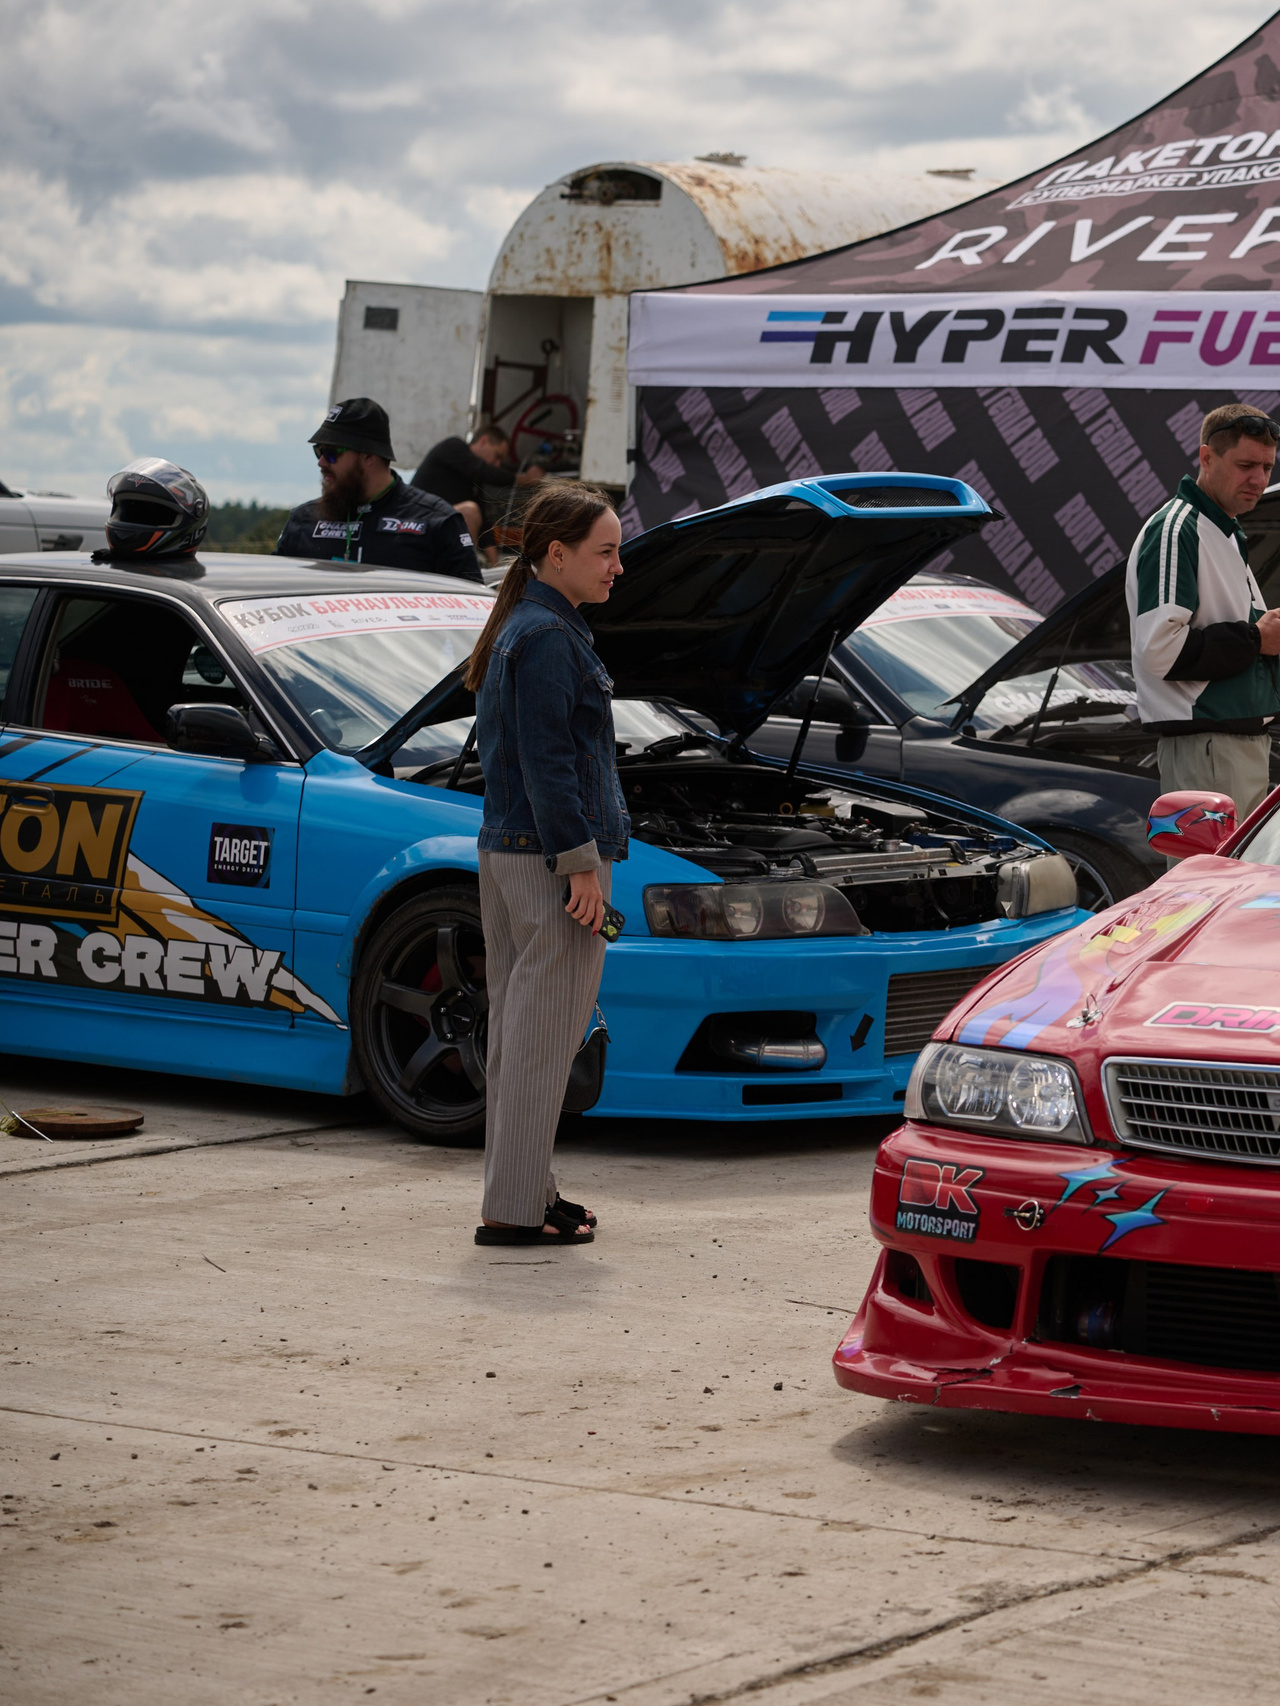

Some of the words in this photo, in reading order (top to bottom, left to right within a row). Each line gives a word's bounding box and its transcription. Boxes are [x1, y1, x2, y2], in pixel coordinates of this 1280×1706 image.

[1022, 172, 1197, 205] СУПЕРМАРКЕТ
[800, 308, 1131, 365] HYPER
[233, 602, 313, 629] КУБОК
[308, 594, 469, 615] БАРНАУЛЬСКОЙ
[68, 678, 113, 689] BRIDE
[0, 794, 125, 880] ON
[214, 836, 268, 866] TARGET
[214, 864, 240, 873] ENERGY
[242, 866, 264, 874] DRINK
[77, 931, 281, 1002] CREW
[899, 1159, 984, 1215] DK
[896, 1211, 977, 1239] MOTORSPORT
